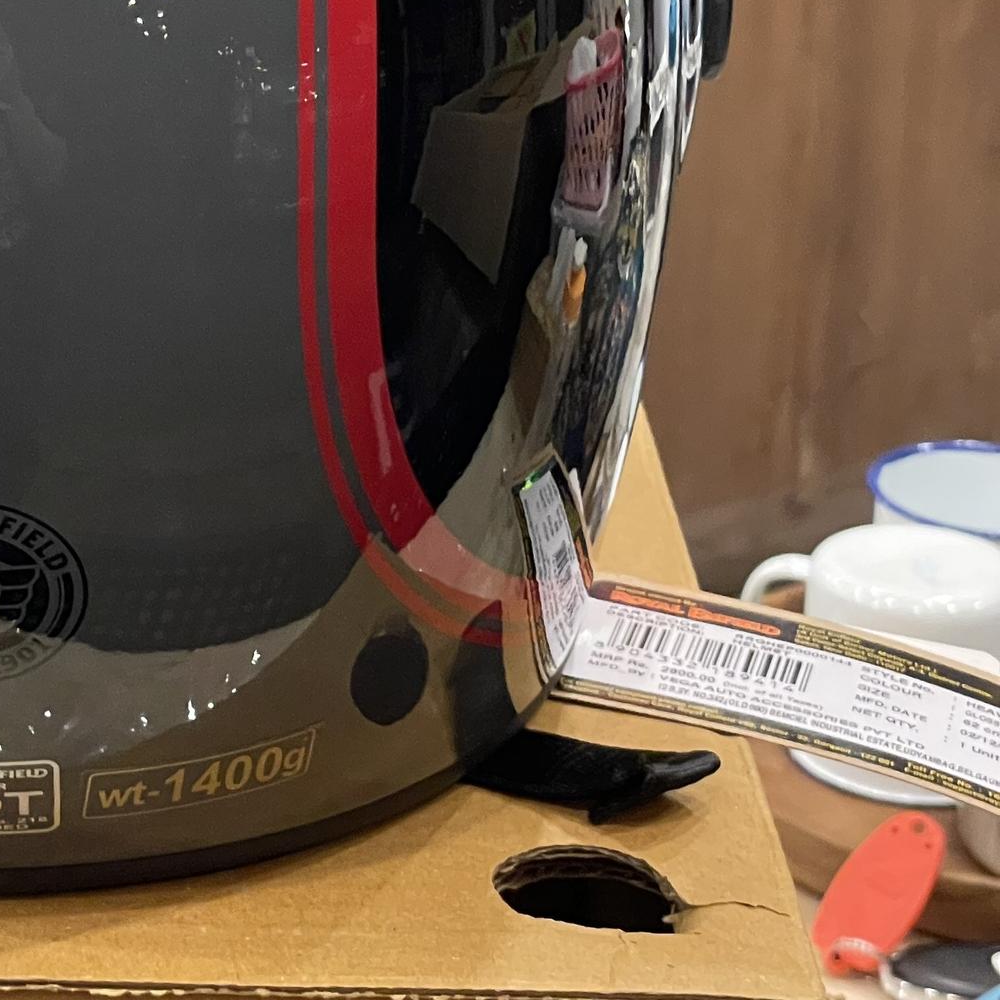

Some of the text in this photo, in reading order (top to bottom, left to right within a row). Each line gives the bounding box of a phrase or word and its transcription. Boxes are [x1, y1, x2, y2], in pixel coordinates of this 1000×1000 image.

[860, 674, 922, 698] COLOUR
[861, 666, 908, 686] STYLE
[857, 683, 890, 699] SIZE
[660, 674, 700, 689] VEGA
[703, 685, 747, 699] AUTO
[750, 696, 859, 729] ACCESSORIES
[863, 725, 892, 738] PVT
[896, 735, 926, 750] LTD
[852, 705, 882, 719] NET
[891, 705, 928, 723] DATE
[811, 719, 864, 741] INDUSTRIAL
[98, 744, 307, 810] wt-1400g
